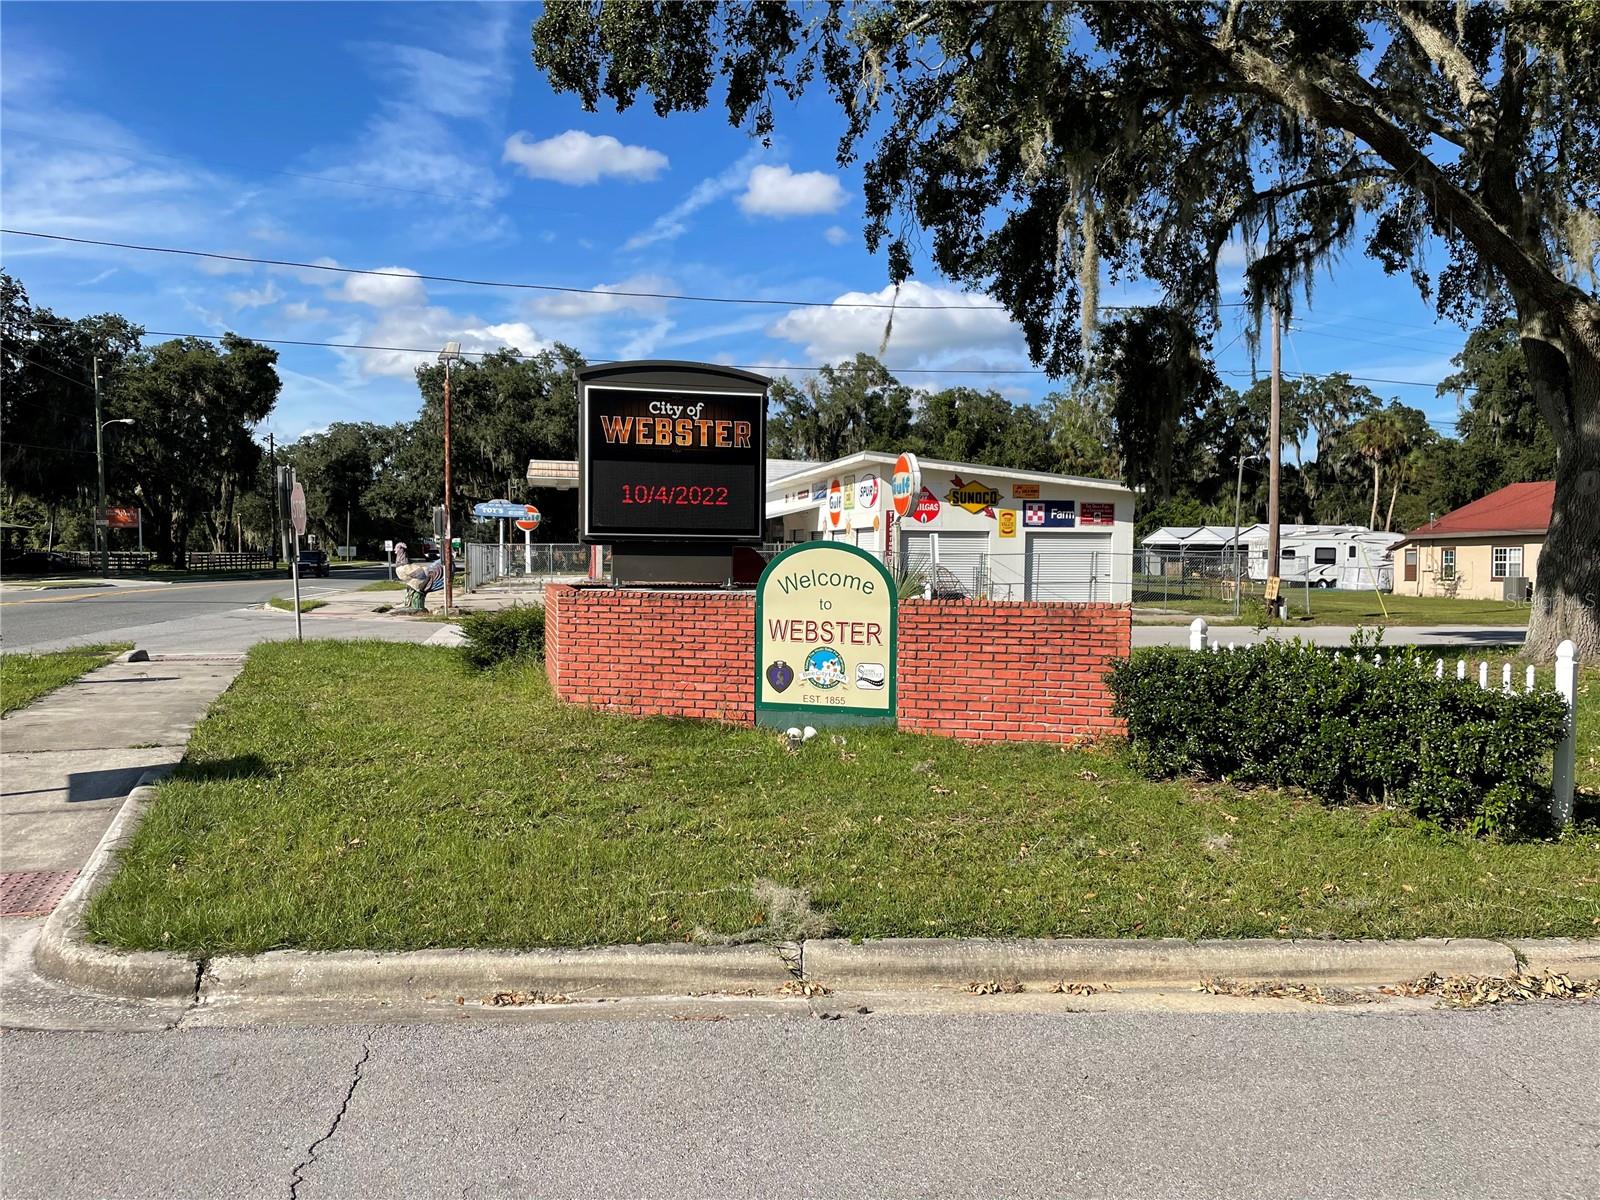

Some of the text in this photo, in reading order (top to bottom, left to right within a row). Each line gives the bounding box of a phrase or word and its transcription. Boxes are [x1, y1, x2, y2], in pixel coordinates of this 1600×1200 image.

[649, 401, 705, 420] City of
[600, 415, 751, 448] WEBSTER
[622, 484, 728, 506] 10/4/2022
[860, 485, 874, 498] SPUR
[951, 490, 998, 505] SUNOCO
[829, 495, 841, 510] Gulf
[1050, 508, 1075, 519] Farm
[778, 569, 875, 595] Welcome
[820, 598, 832, 611] to
[769, 619, 883, 647] WEBSTER
[803, 694, 846, 705] EST. 1855
